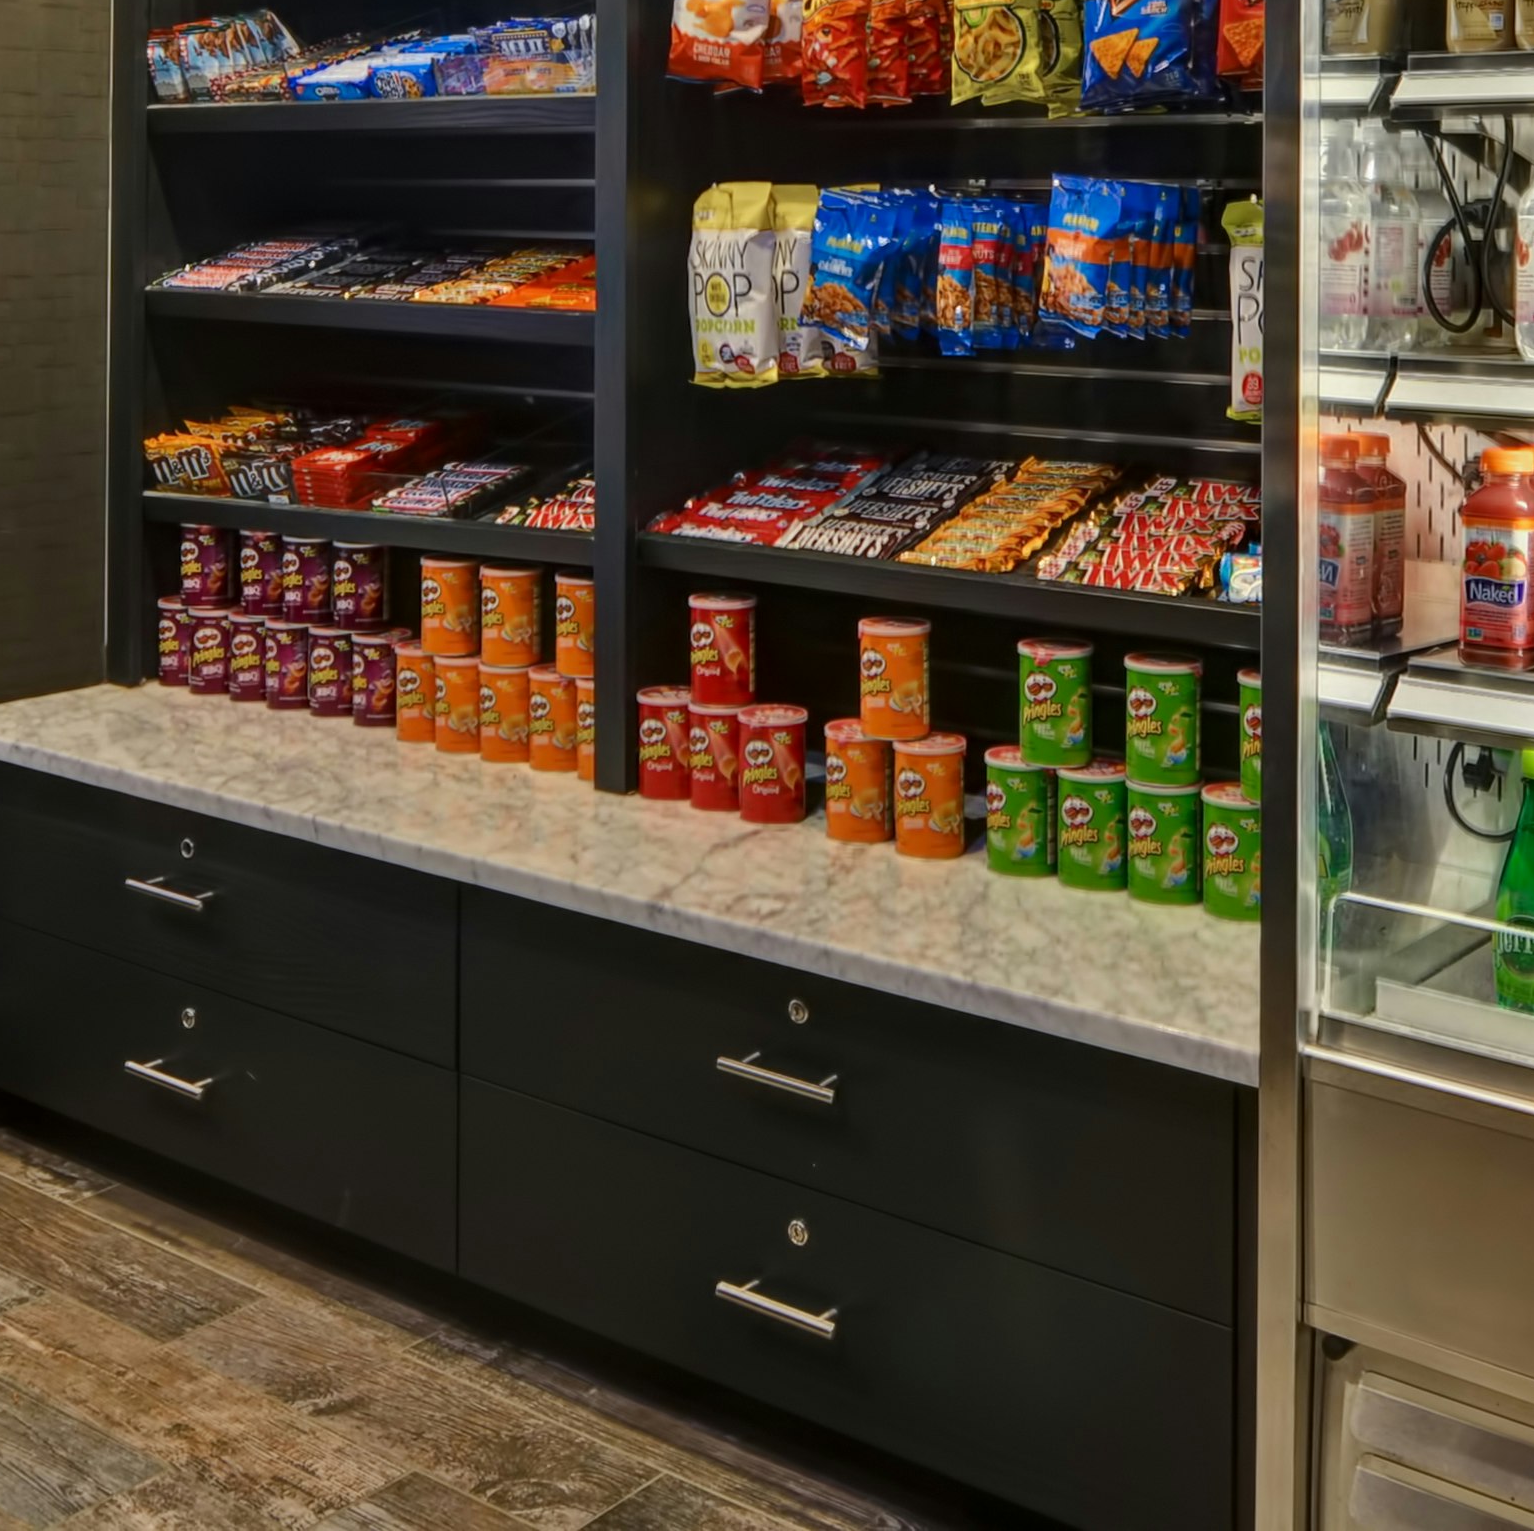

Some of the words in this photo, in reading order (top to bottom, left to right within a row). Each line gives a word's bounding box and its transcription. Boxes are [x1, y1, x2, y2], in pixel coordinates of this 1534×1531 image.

[692, 239, 749, 270] SKINNY
[693, 271, 752, 318] POP
[695, 318, 756, 335] POPCORN
[1468, 580, 1521, 605] Naked
